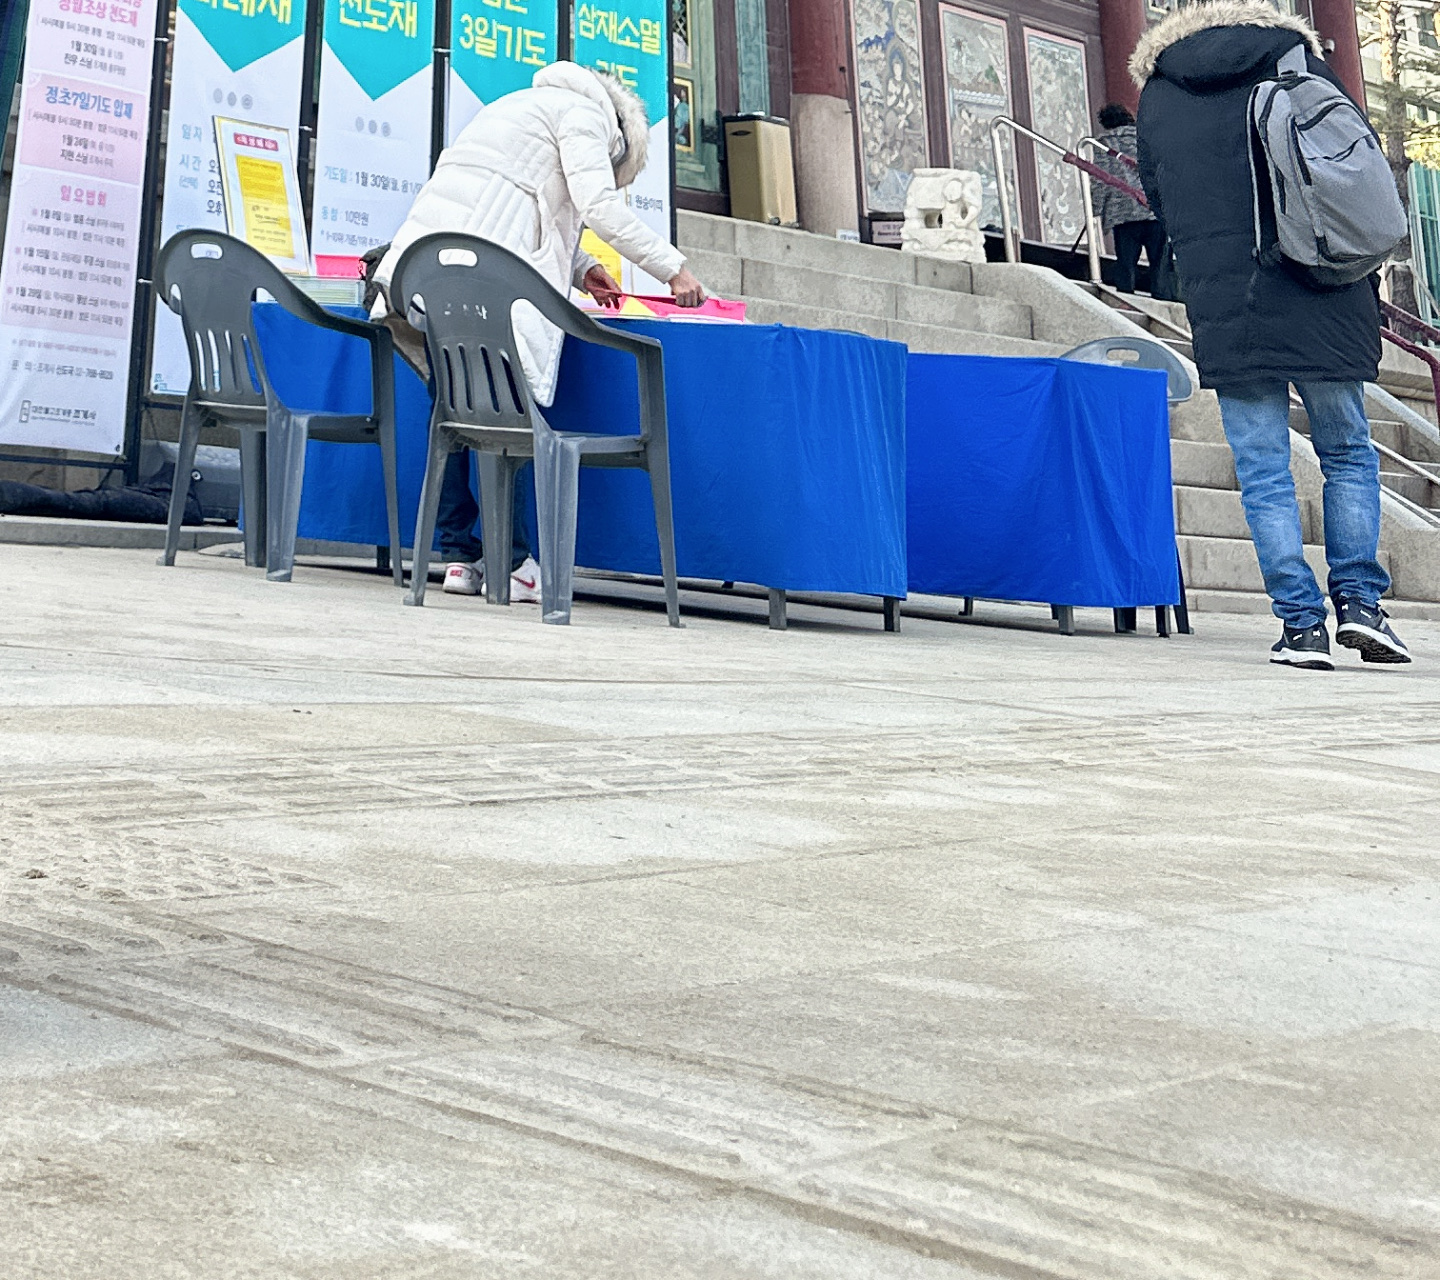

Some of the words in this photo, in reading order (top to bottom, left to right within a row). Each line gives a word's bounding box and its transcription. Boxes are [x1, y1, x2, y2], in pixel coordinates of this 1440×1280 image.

[459, 13, 547, 66] 3일기도
[578, 3, 661, 56] 삼재소멸
[179, 154, 201, 172] 시간
[355, 171, 368, 187] 1월
